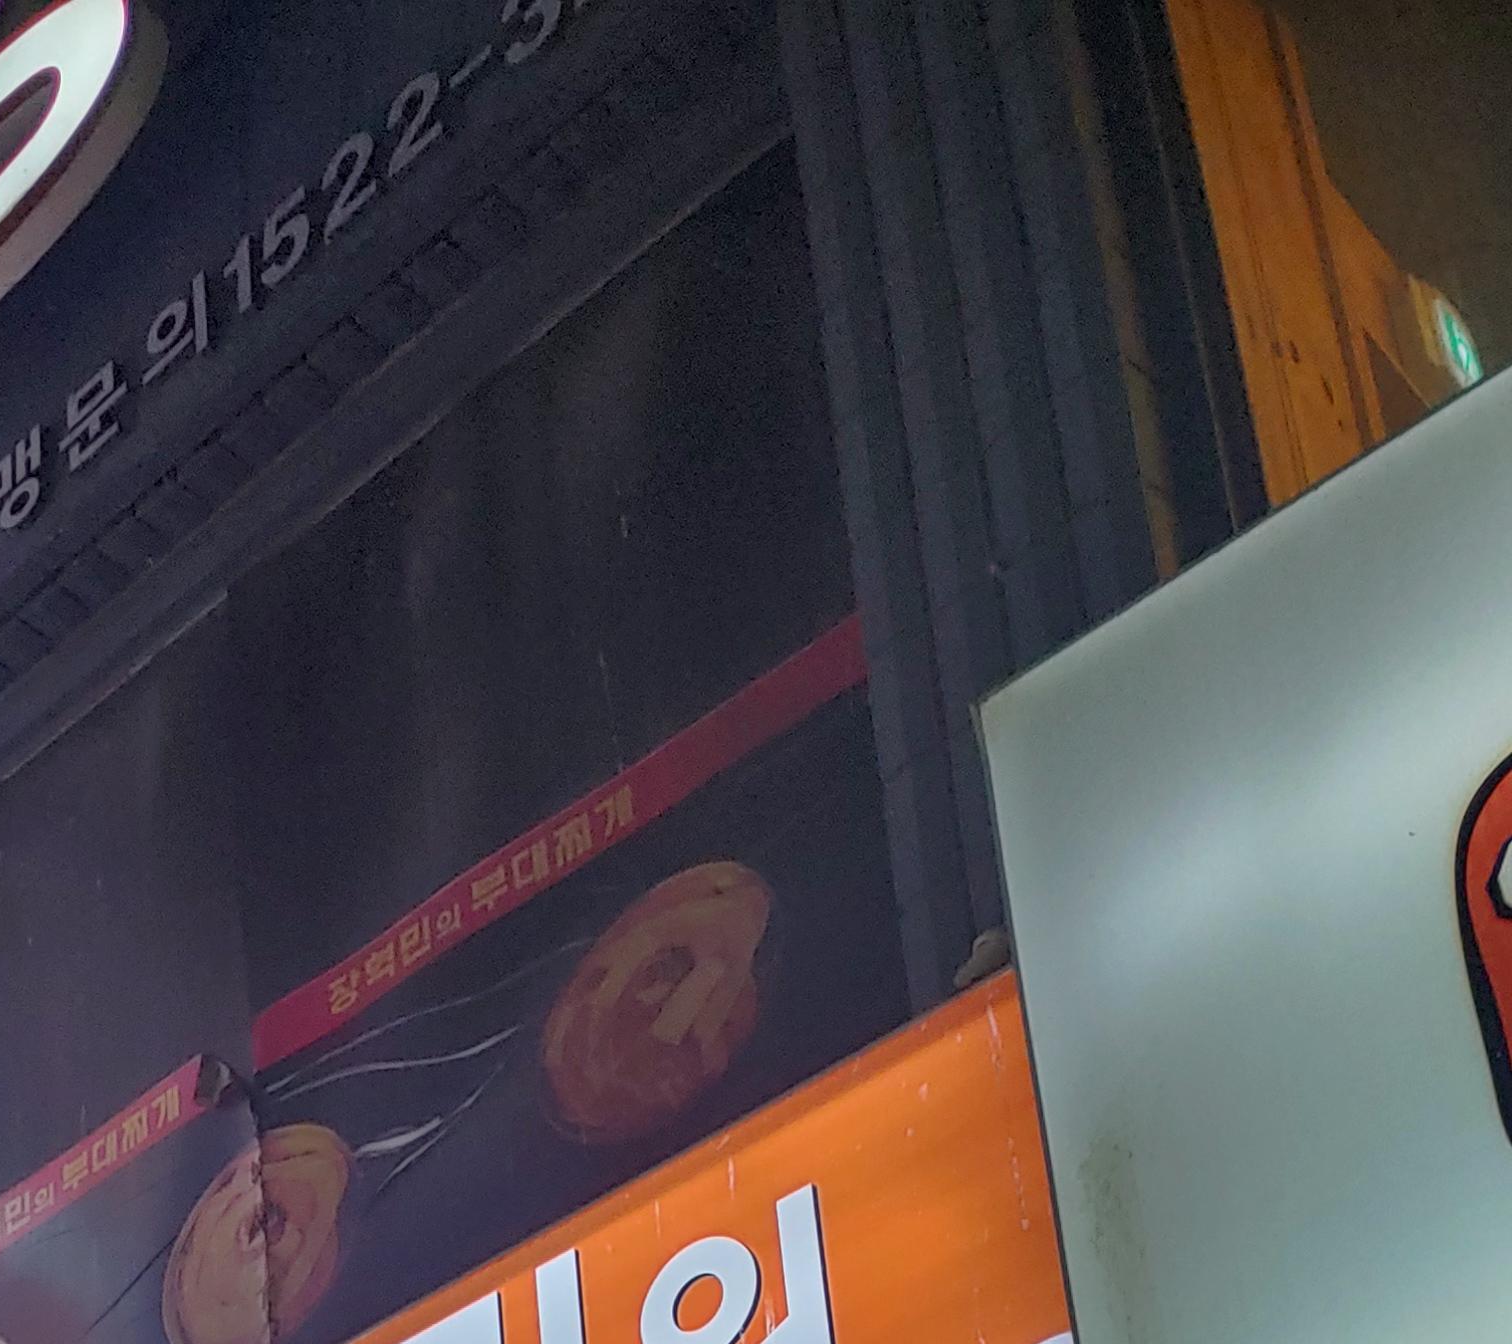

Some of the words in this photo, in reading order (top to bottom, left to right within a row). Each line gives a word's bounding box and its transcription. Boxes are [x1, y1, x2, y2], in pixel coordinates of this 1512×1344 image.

[327, 904, 462, 1014] 장혁민의
[471, 784, 636, 911] 부대찌개
[60, 1084, 181, 1190] 부대찌개
